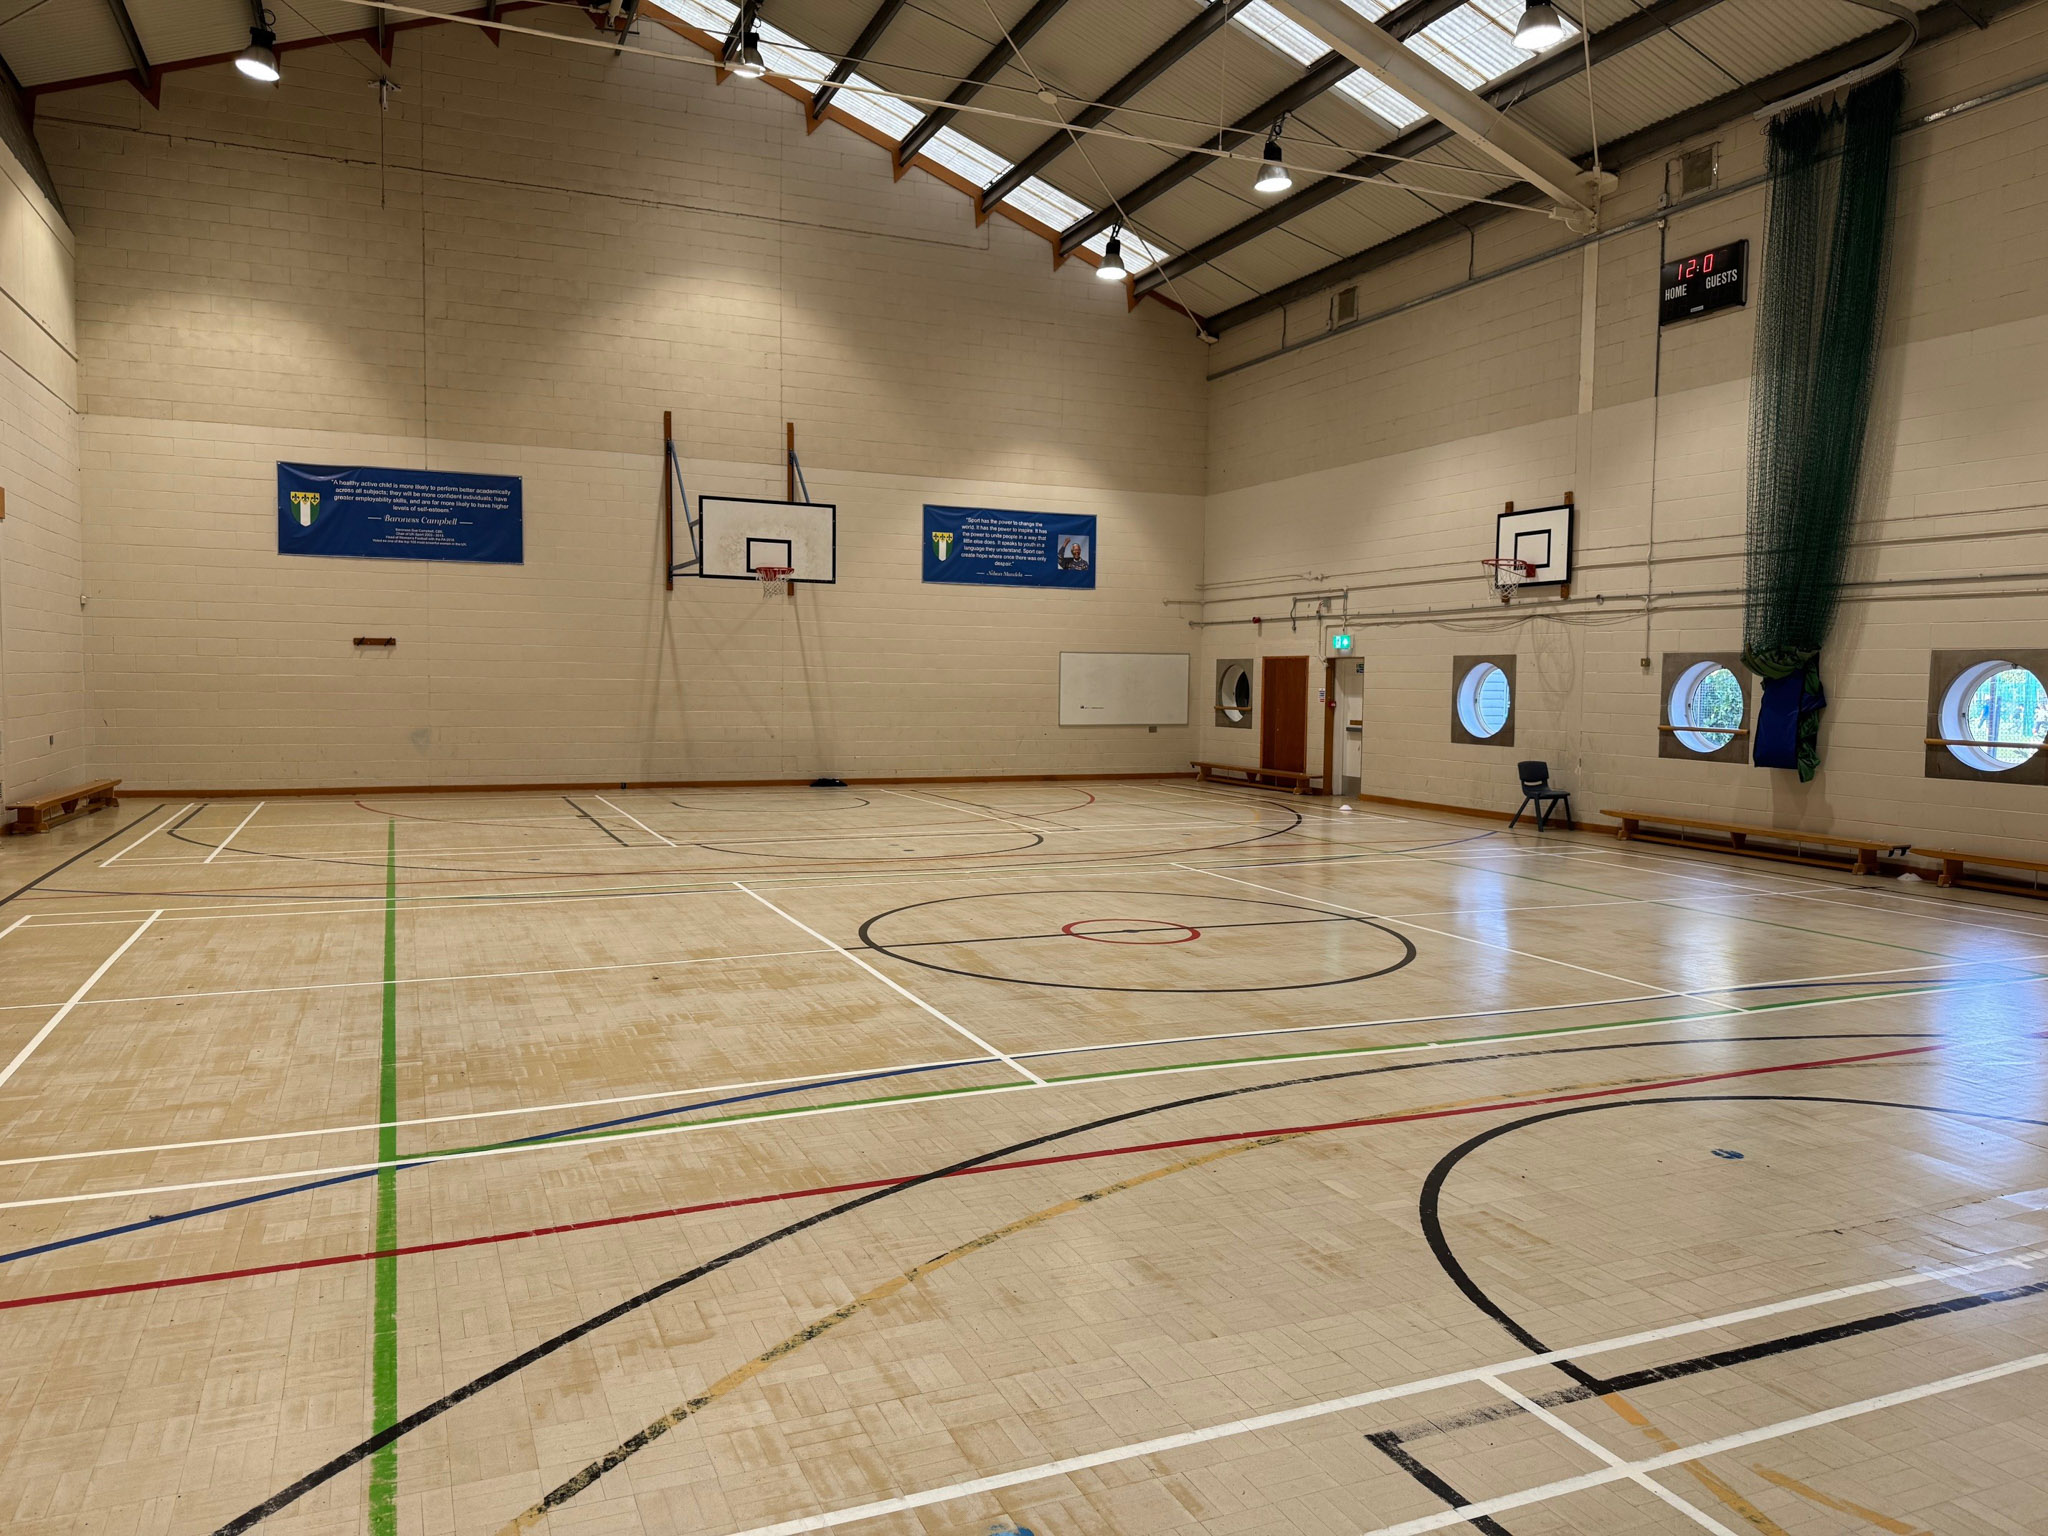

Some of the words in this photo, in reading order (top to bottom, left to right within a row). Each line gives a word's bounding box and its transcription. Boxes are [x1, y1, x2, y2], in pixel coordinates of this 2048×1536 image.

[1665, 284, 1688, 301] HOME
[1706, 269, 1738, 289] GUESTS
[384, 514, 419, 523] Baroness
[421, 516, 458, 526] Campbell
